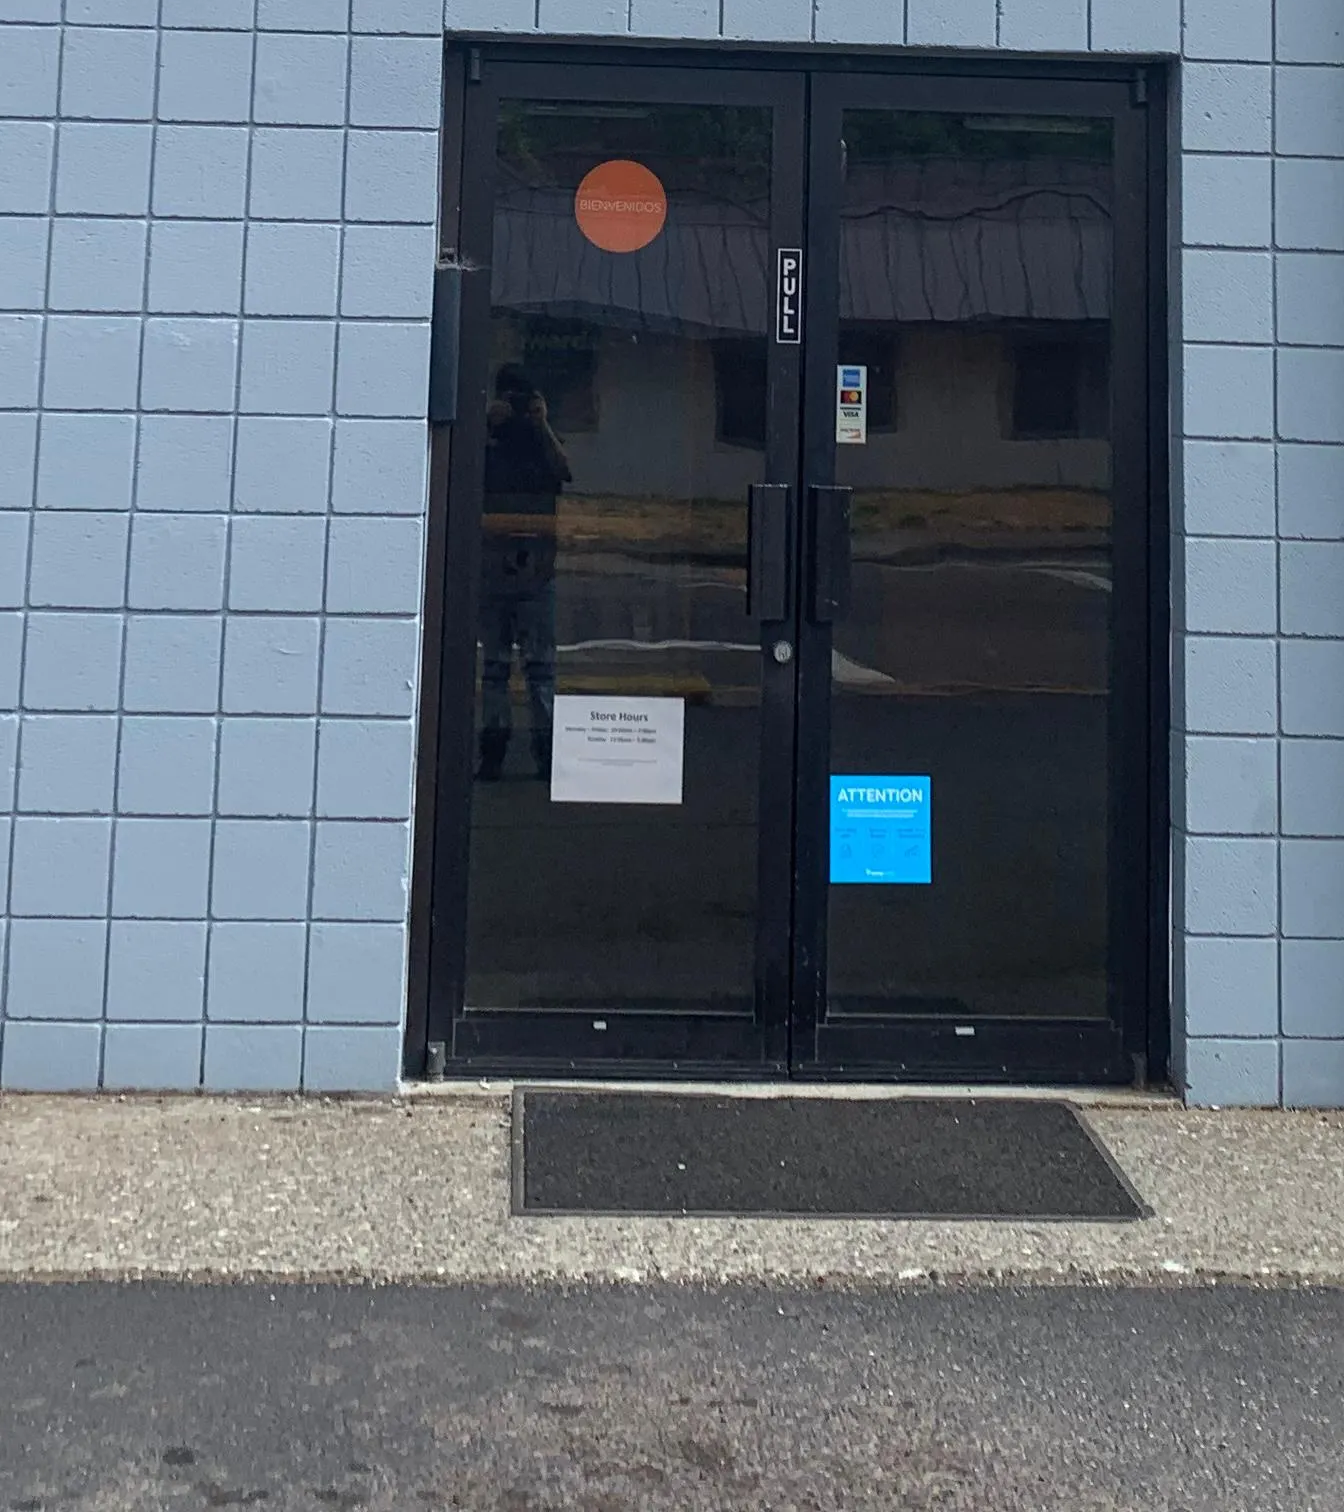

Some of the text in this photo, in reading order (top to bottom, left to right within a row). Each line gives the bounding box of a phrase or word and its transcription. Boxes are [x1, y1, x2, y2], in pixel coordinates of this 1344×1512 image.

[579, 199, 662, 213] BIENVENIDOS
[783, 258, 797, 334] PULL
[590, 711, 649, 722] Store Hours
[837, 787, 923, 803] ATTENTION
